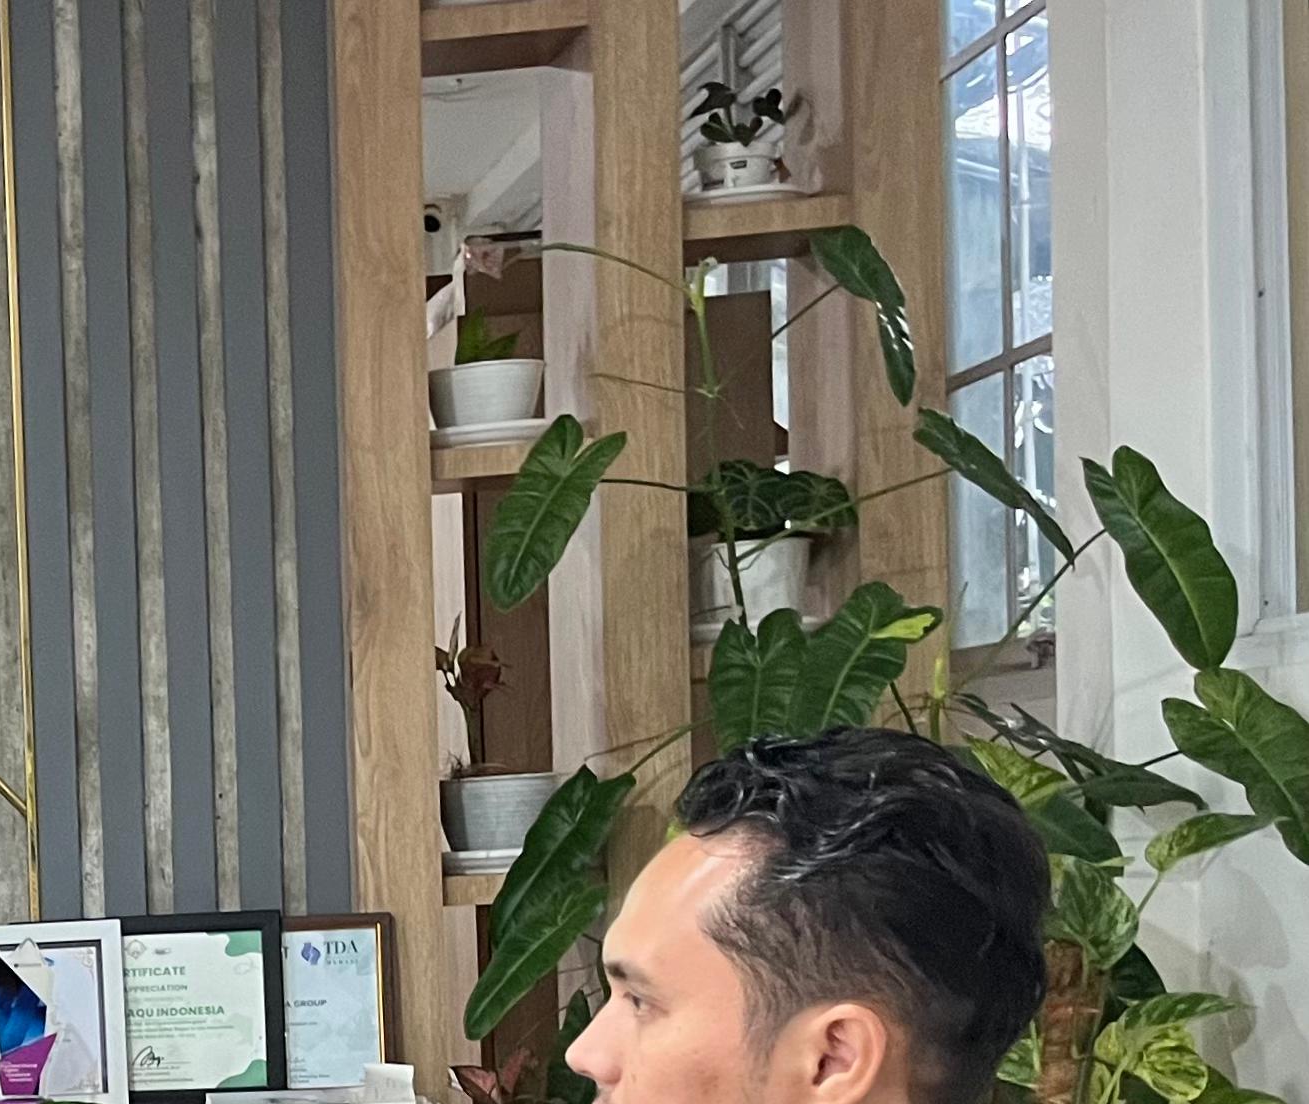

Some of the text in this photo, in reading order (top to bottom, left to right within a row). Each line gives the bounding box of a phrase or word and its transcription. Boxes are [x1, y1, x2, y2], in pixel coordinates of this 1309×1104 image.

[323, 940, 359, 955] TDA
[123, 966, 186, 977] RTIFICATE
[156, 1005, 225, 1017] INDONESIA
